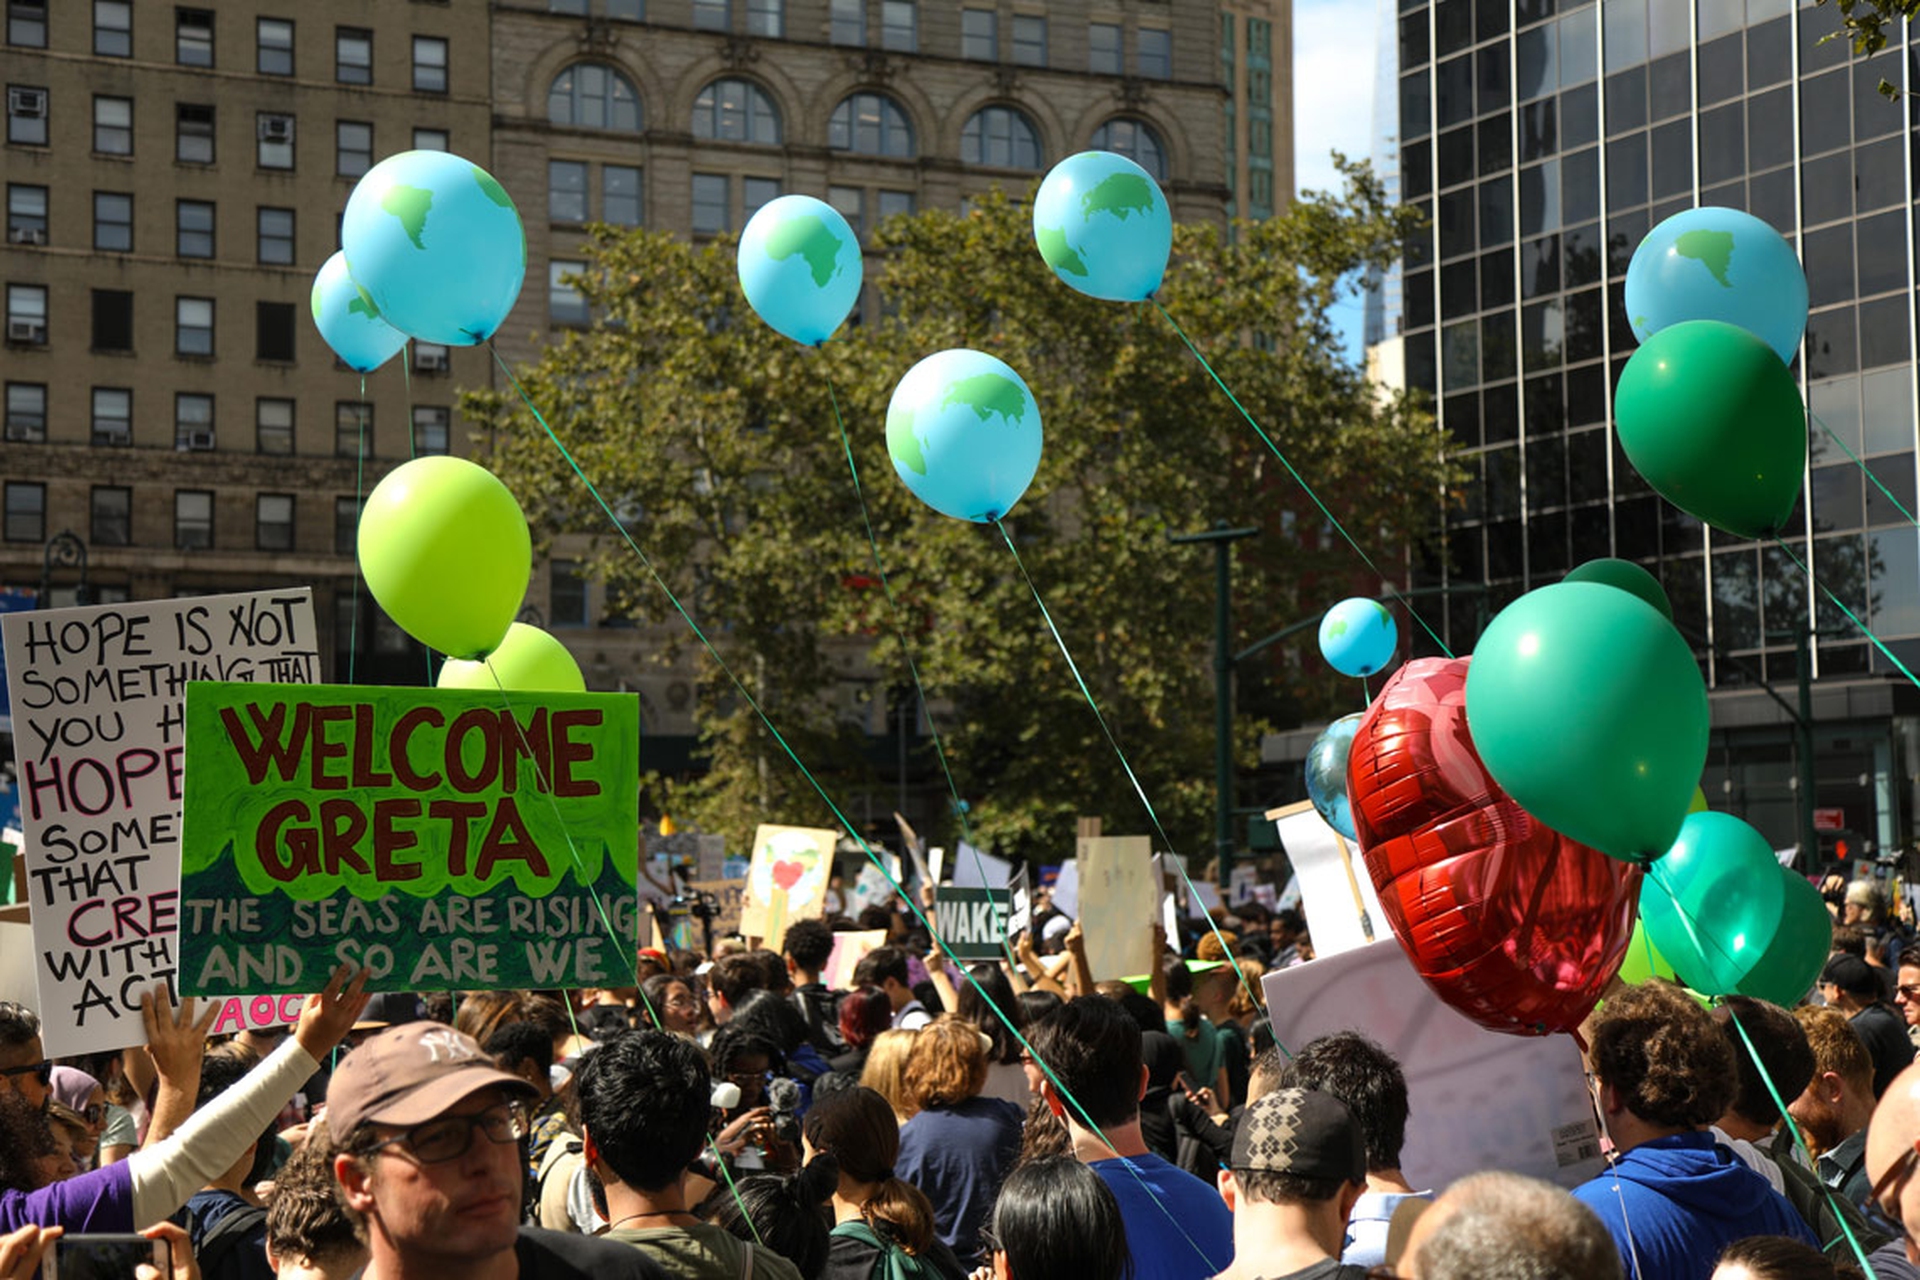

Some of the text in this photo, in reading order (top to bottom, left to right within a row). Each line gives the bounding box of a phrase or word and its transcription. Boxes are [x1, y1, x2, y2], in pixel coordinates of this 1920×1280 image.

[25, 597, 308, 666] HOPE IS NOT
[259, 651, 319, 684] THAT
[28, 711, 125, 766] YOU
[219, 702, 603, 797] WELCOME
[41, 811, 182, 865] SOME
[255, 797, 550, 882] GRETA
[31, 856, 150, 906] THAT
[67, 890, 179, 947] CRE
[185, 892, 635, 942] THE SEAS ARE RISING
[937, 901, 1009, 944] WAKE
[44, 937, 172, 981] WITH
[197, 937, 608, 988] AND SO ARE WE
